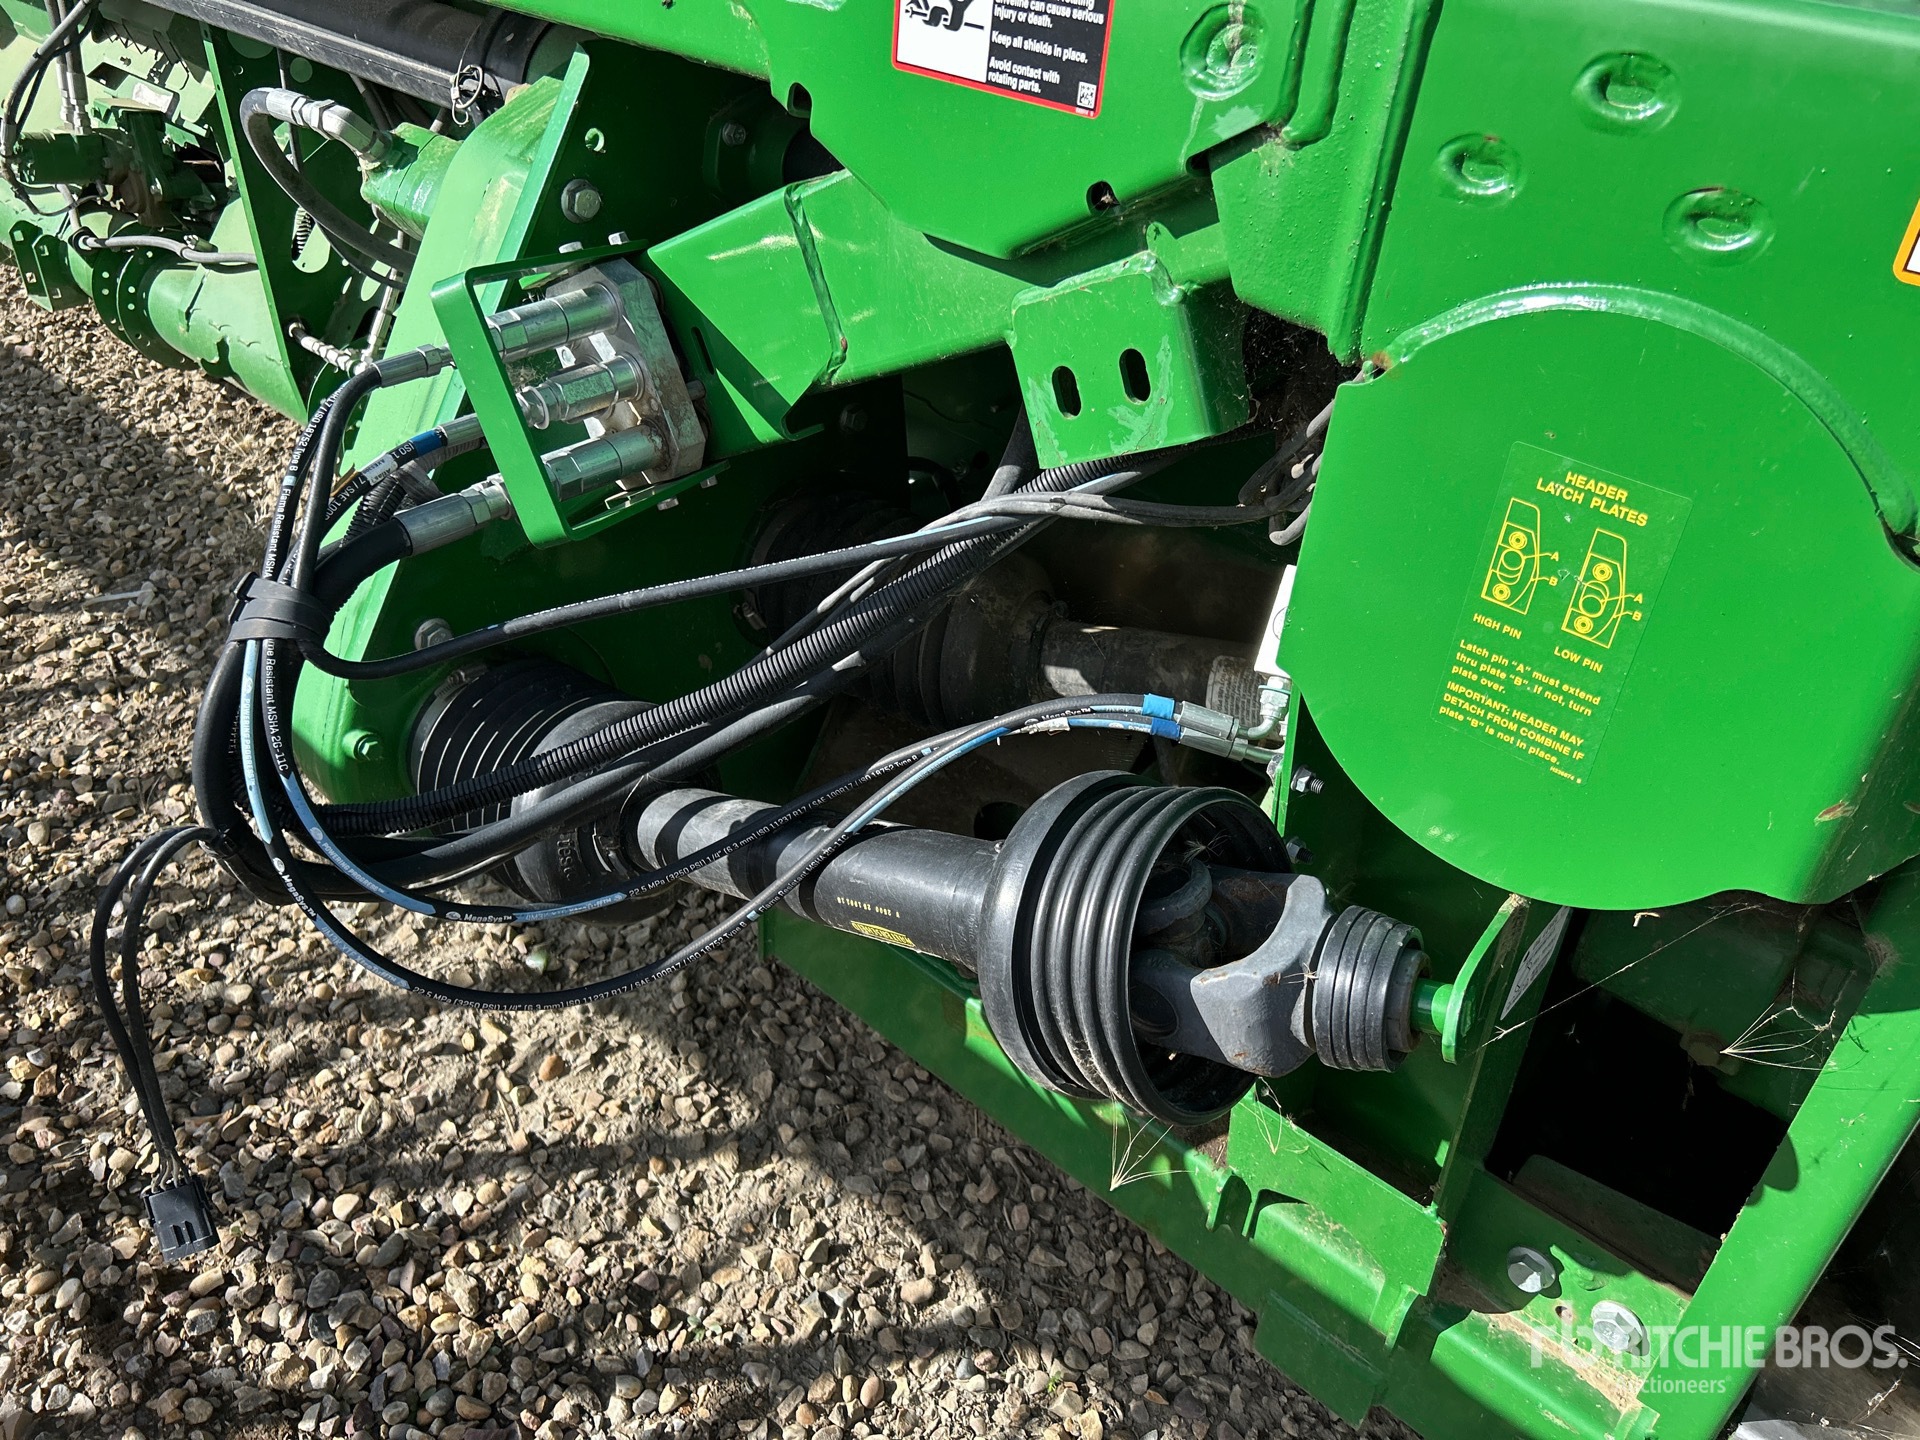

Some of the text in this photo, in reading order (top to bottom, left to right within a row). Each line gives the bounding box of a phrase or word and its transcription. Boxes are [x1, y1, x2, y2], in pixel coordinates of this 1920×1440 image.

[994, 4, 1053, 28] injury or death.
[1029, 0, 1045, 13] can
[1046, 3, 1071, 18] cause
[1072, 8, 1104, 25] serious
[991, 30, 1088, 64] Keep all shields in place.
[988, 71, 1042, 93] rotating parts.
[989, 56, 1060, 84] Avoid contact with
[311, 411, 326, 424] ISO
[299, 422, 317, 447] 18752
[292, 446, 306, 466] Type
[339, 486, 356, 503] SAE
[1565, 471, 1628, 503] HEADER
[1536, 477, 1648, 526] LATCH PLATES
[262, 487, 292, 579] Flame Resistant MSHA
[1550, 552, 1560, 562] A
[1549, 577, 1559, 587] B
[1633, 594, 1643, 604] A
[1473, 613, 1522, 640] HIGH PIN
[1632, 611, 1642, 621] B
[1460, 639, 1489, 658] Latch
[1490, 654, 1509, 667] pin
[1532, 671, 1560, 688] must
[1562, 684, 1601, 705] extend
[1553, 646, 1603, 673] LOW PIN
[264, 658, 277, 704] Resistant
[1451, 665, 1506, 694] plate over.
[1456, 652, 1478, 667] thru
[1479, 663, 1507, 680] plate
[1533, 684, 1543, 694] If
[1544, 691, 1565, 707] not,
[1568, 700, 1592, 717] turn
[267, 706, 279, 735] MSHA
[1443, 693, 1585, 760] DETACH FROM COMBINE IF
[1446, 681, 1584, 747] IMPORTANT: HEADER MAY
[1439, 706, 1464, 721] plate
[1485, 725, 1495, 735] is
[1497, 732, 1515, 744] not
[1516, 739, 1527, 750] in
[1528, 746, 1560, 765] place.
[271, 735, 289, 772] 2G-11C
[648, 879, 665, 891] MPa
[757, 826, 770, 838] ISO
[769, 813, 793, 829] 11237
[792, 805, 808, 817] R17
[811, 796, 827, 808] SAE
[827, 782, 854, 799] 100R17
[758, 834, 850, 913] Flame Resistant MSHA 2G-11C
[433, 993, 452, 1004] MPa
[583, 991, 609, 1004] 11237
